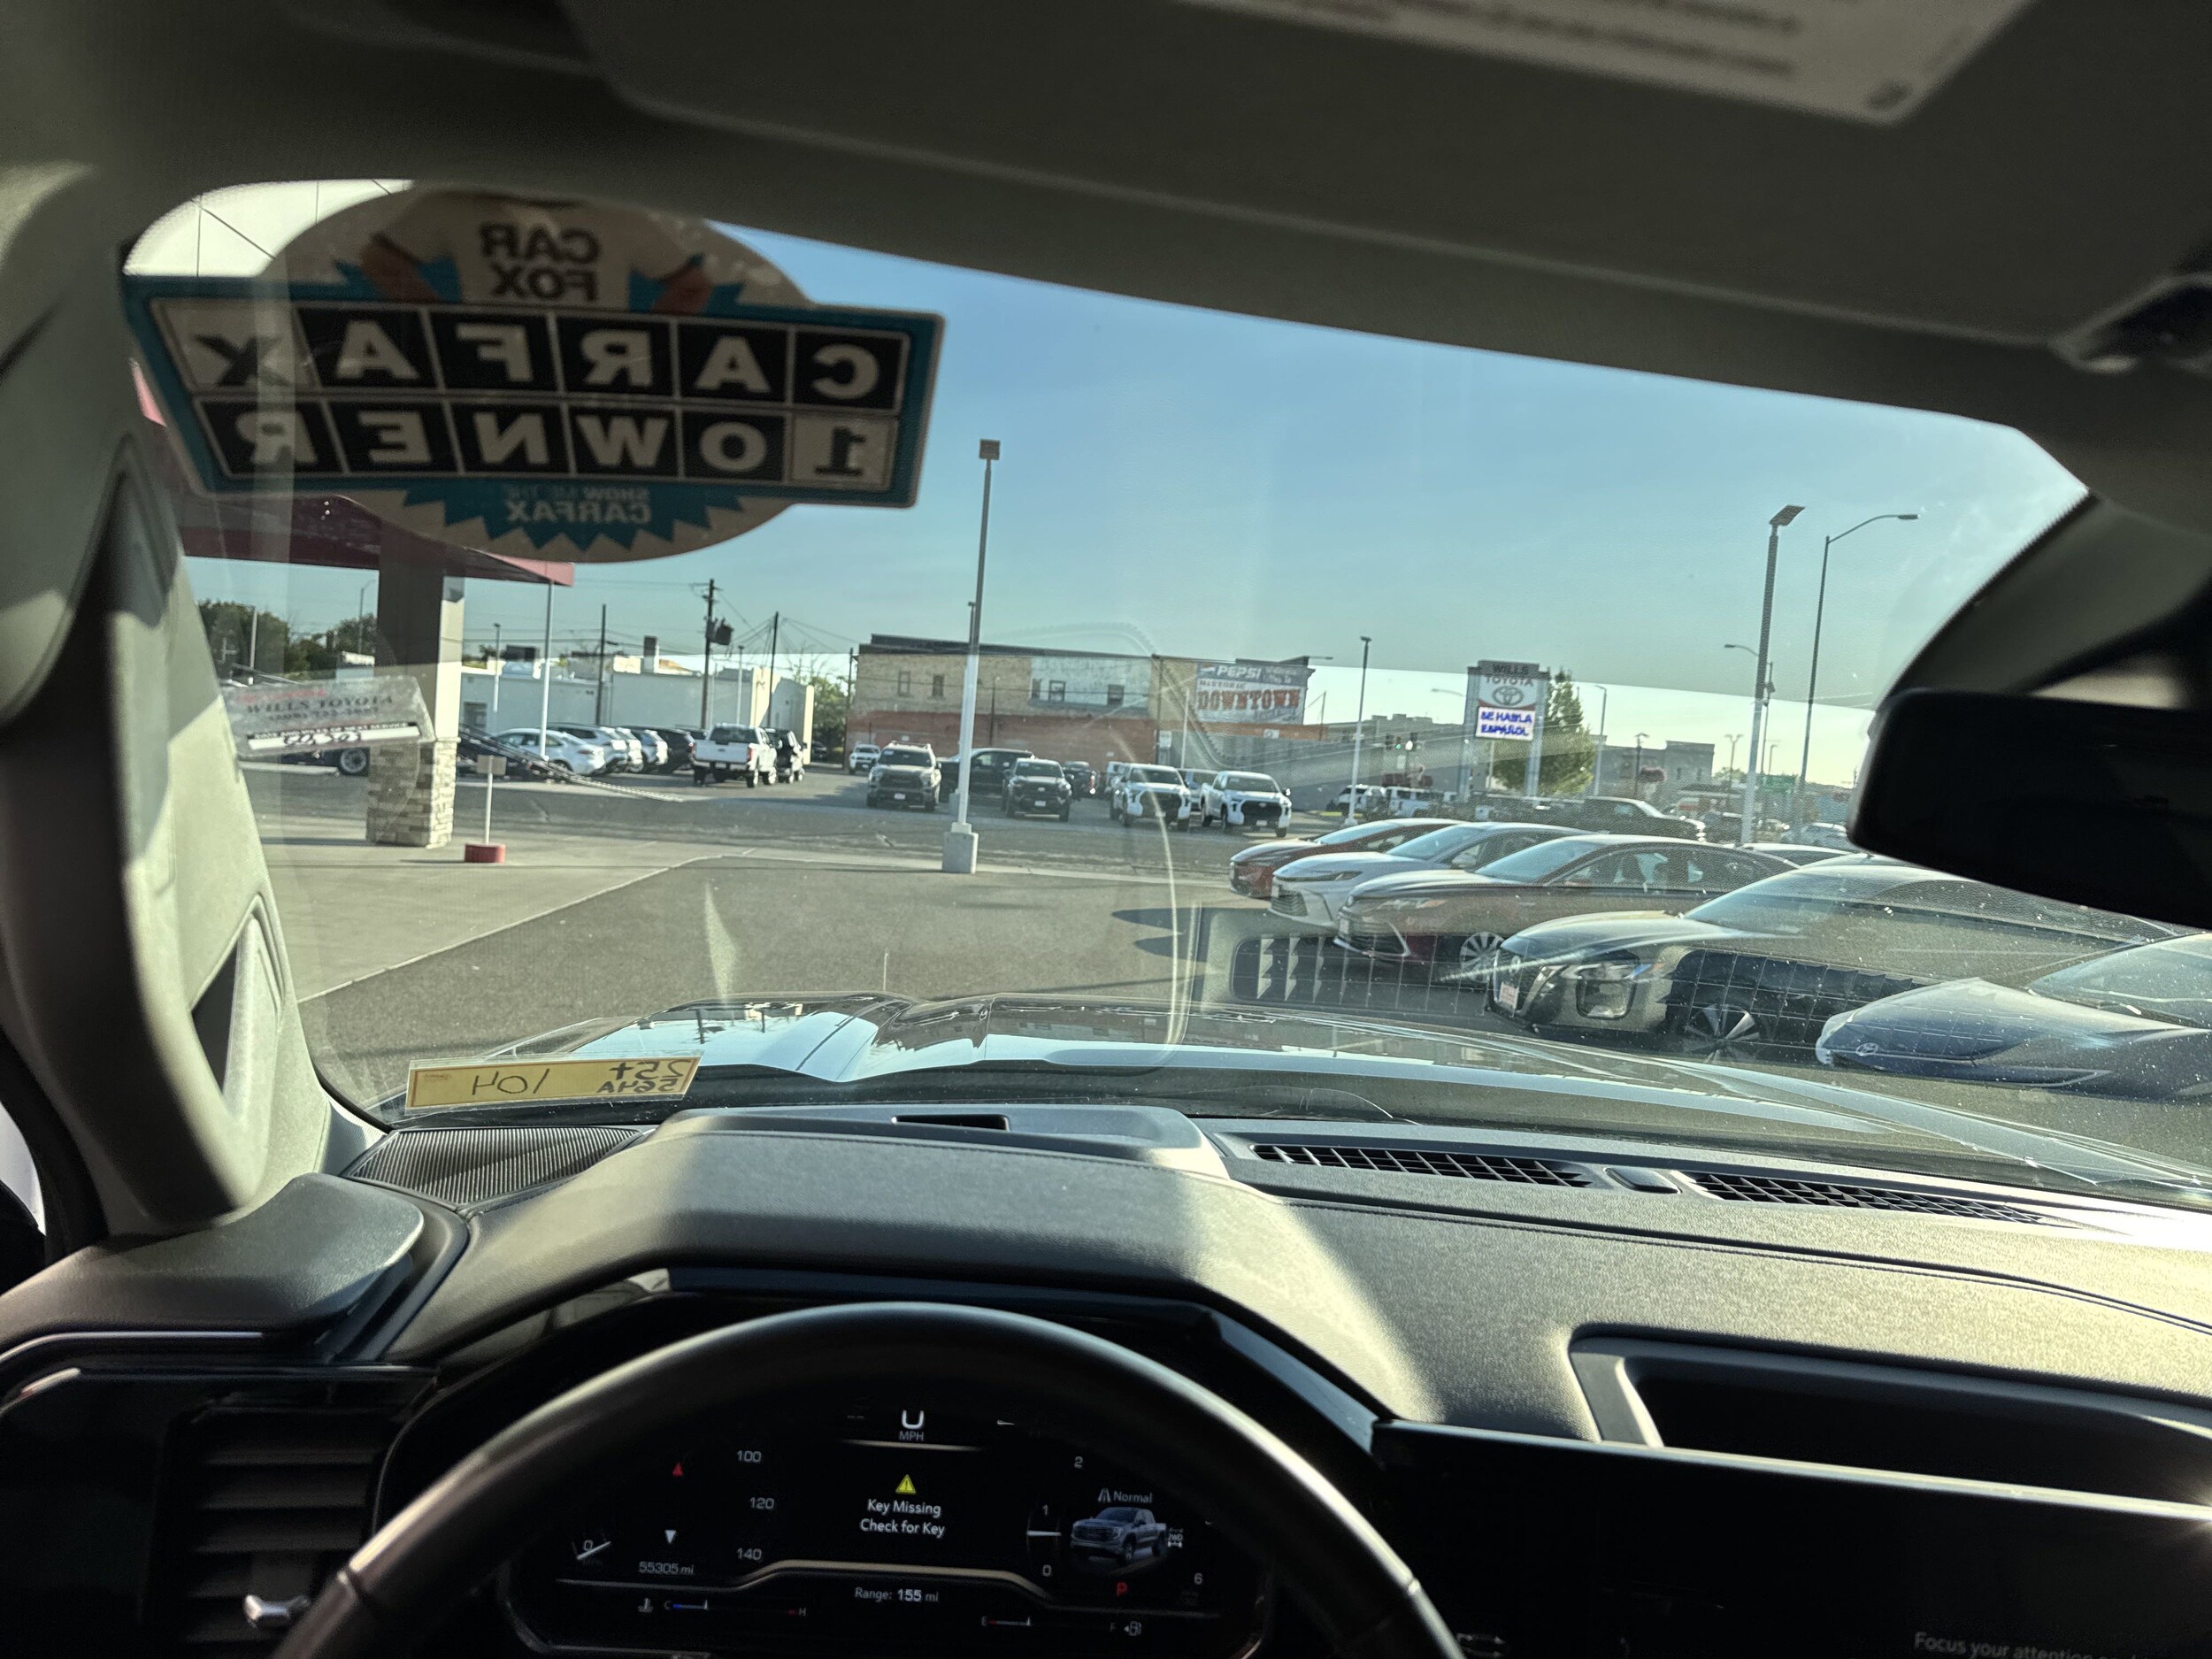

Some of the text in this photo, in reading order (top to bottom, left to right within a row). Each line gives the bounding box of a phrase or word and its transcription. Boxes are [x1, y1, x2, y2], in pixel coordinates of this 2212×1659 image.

[1217, 665, 1262, 679] PEPSI
[1200, 680, 1246, 688] HISTORIC
[1486, 676, 1533, 687] TOYOTA
[248, 701, 310, 714] WILLS
[319, 695, 392, 708] TOYOTA
[1197, 688, 1300, 710] DOWNTOWN
[1481, 711, 1532, 723] SE HABLA
[899, 1430, 925, 1441] MPH
[736, 1449, 762, 1463] 100
[1074, 1455, 1084, 1469] 2
[749, 1496, 775, 1509] 120
[1113, 1490, 1153, 1503] Normal
[867, 1498, 942, 1519] Key Missing
[1041, 1503, 1048, 1516] 1
[859, 1517, 946, 1539] Check for Key
[736, 1547, 763, 1561] 140
[638, 1561, 695, 1576] 55305 mi
[1042, 1564, 1052, 1578] 0
[1194, 1572, 1204, 1586] 6
[855, 1586, 940, 1602] Range: 155 mi
[1117, 1582, 1129, 1596] P
[1913, 1631, 1966, 1654] Focus
[1967, 1642, 2010, 1659] your
